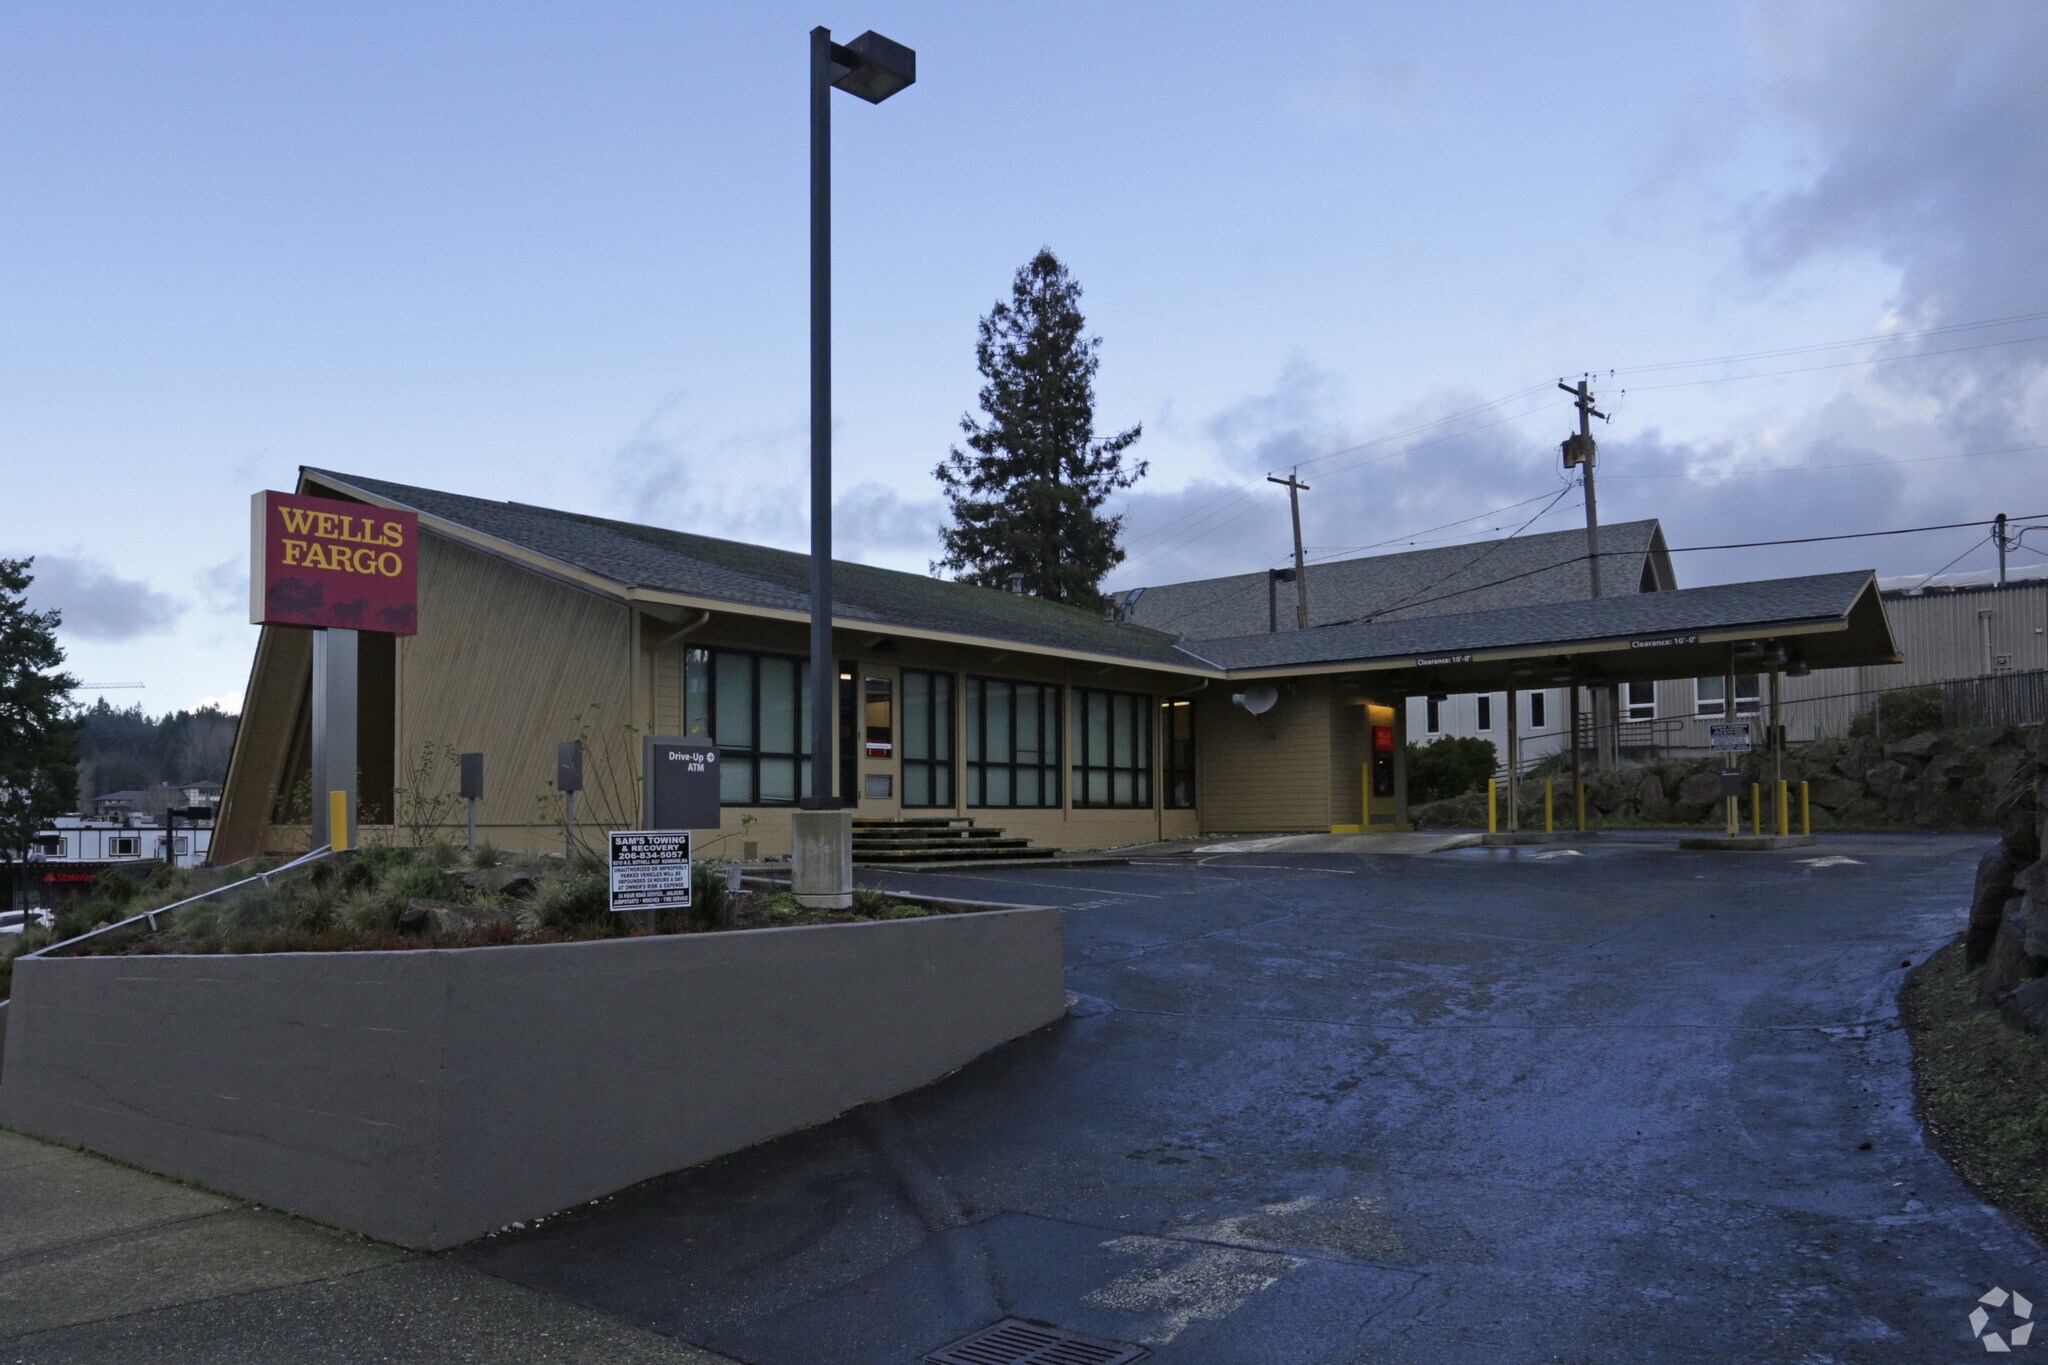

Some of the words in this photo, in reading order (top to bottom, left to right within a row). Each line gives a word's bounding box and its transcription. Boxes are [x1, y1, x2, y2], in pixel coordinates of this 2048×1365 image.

[278, 506, 403, 547] WELLS
[282, 538, 402, 577] FARGO
[1632, 638, 1672, 648] Clearance:
[1417, 657, 1452, 666] Clearance:
[668, 751, 704, 763] Drive-Up
[688, 763, 704, 772] ATM
[615, 837, 645, 846] SAM'S
[648, 836, 686, 844] TOWING
[618, 851, 683, 860] 206-834-5057
